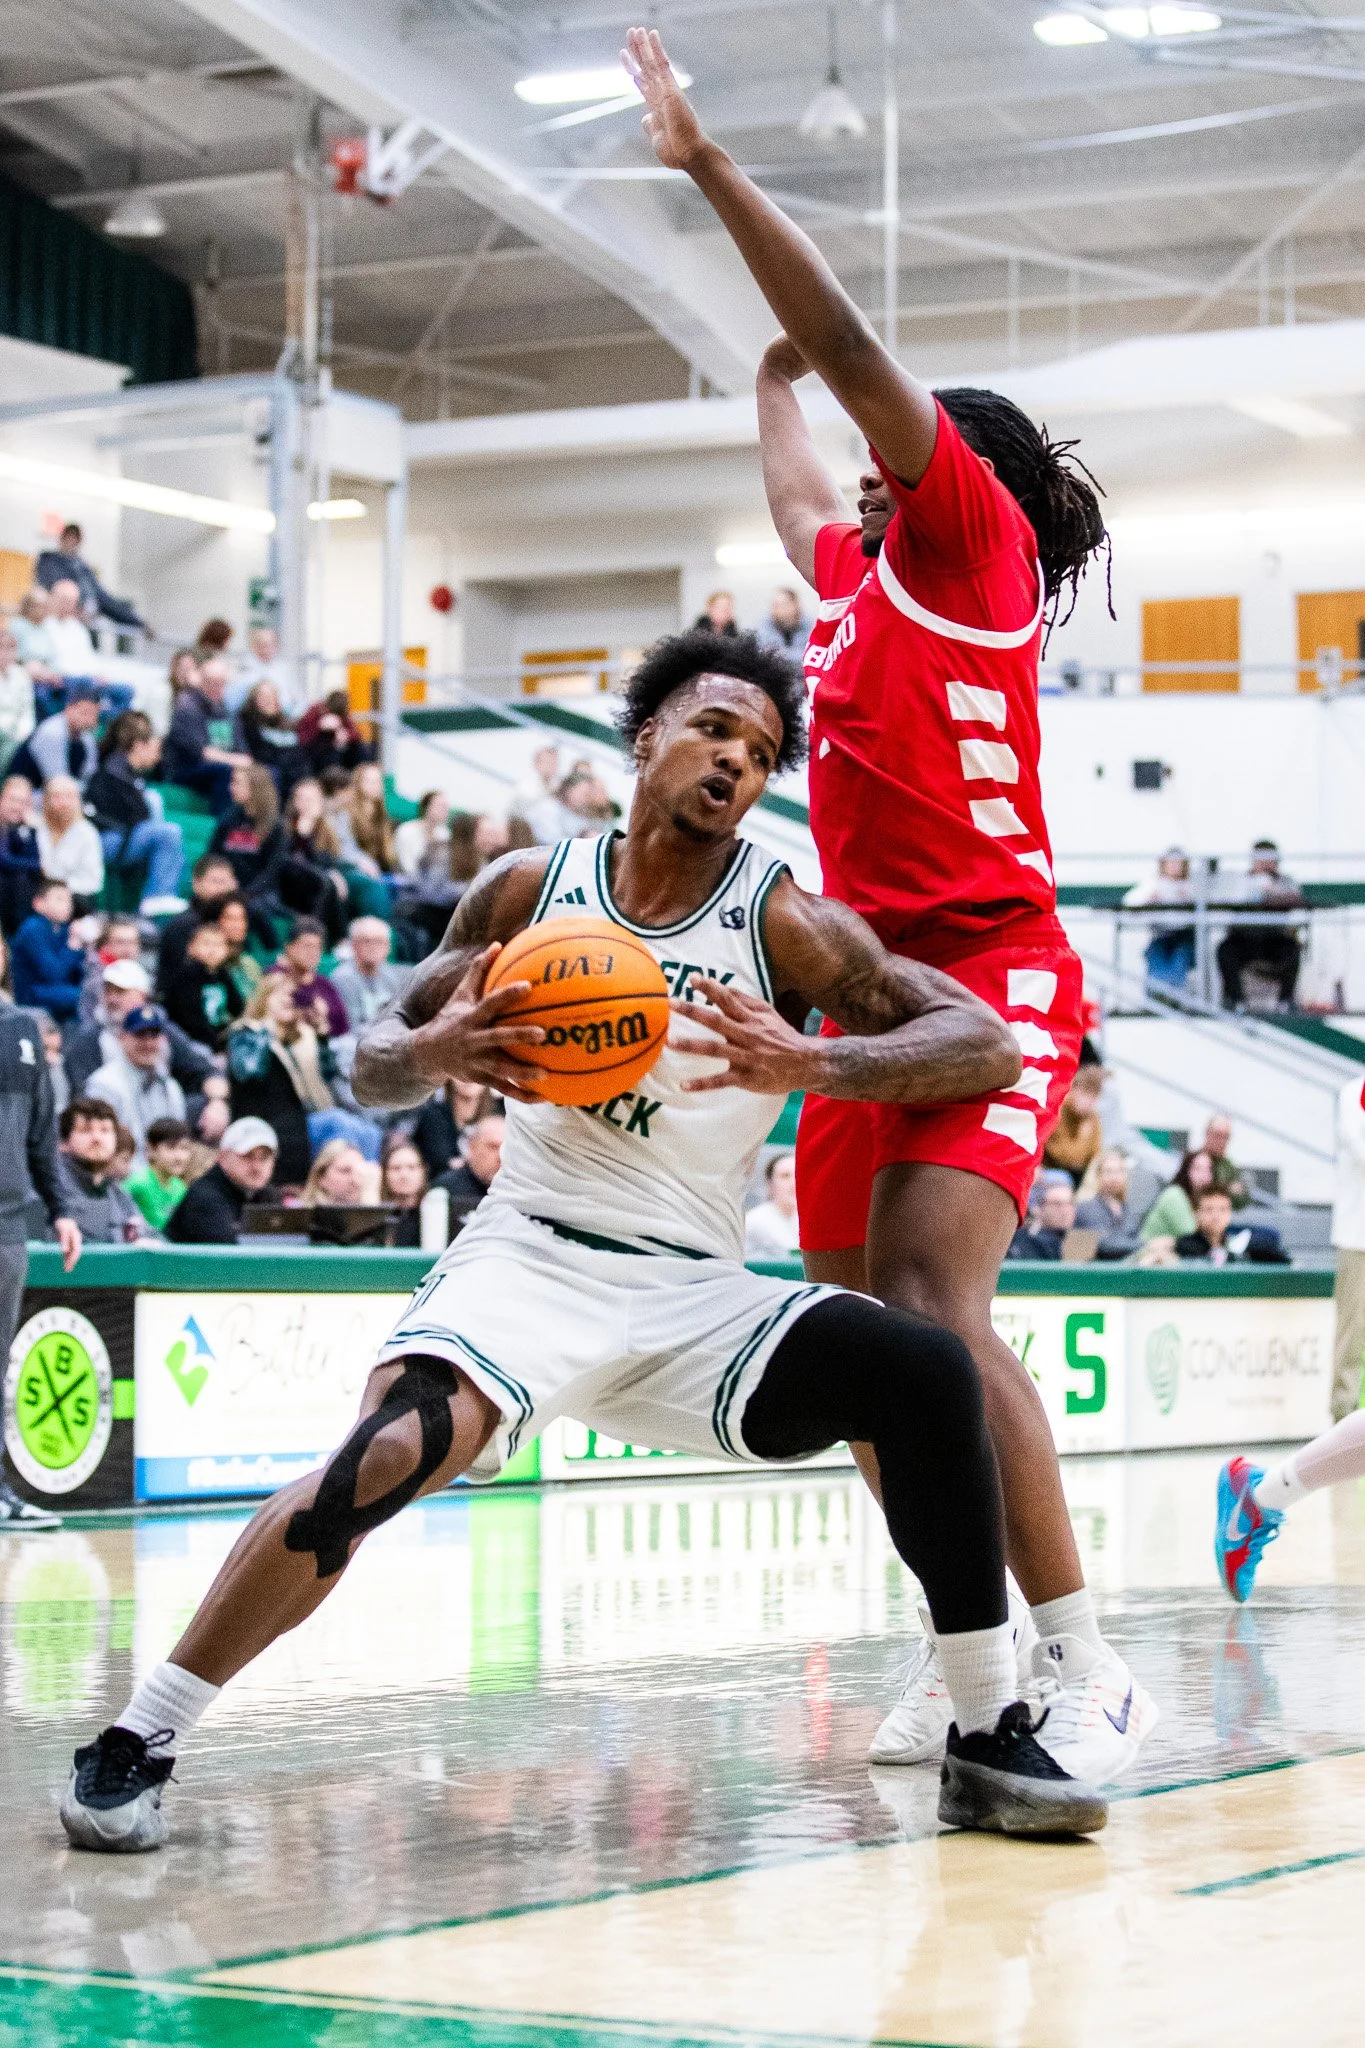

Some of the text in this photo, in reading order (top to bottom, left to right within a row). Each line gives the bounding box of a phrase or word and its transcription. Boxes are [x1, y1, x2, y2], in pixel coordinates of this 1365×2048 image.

[803, 612, 856, 672] BORO
[1065, 1313, 1106, 1415] S
[1184, 1336, 1321, 1379] CONFLUENCE
